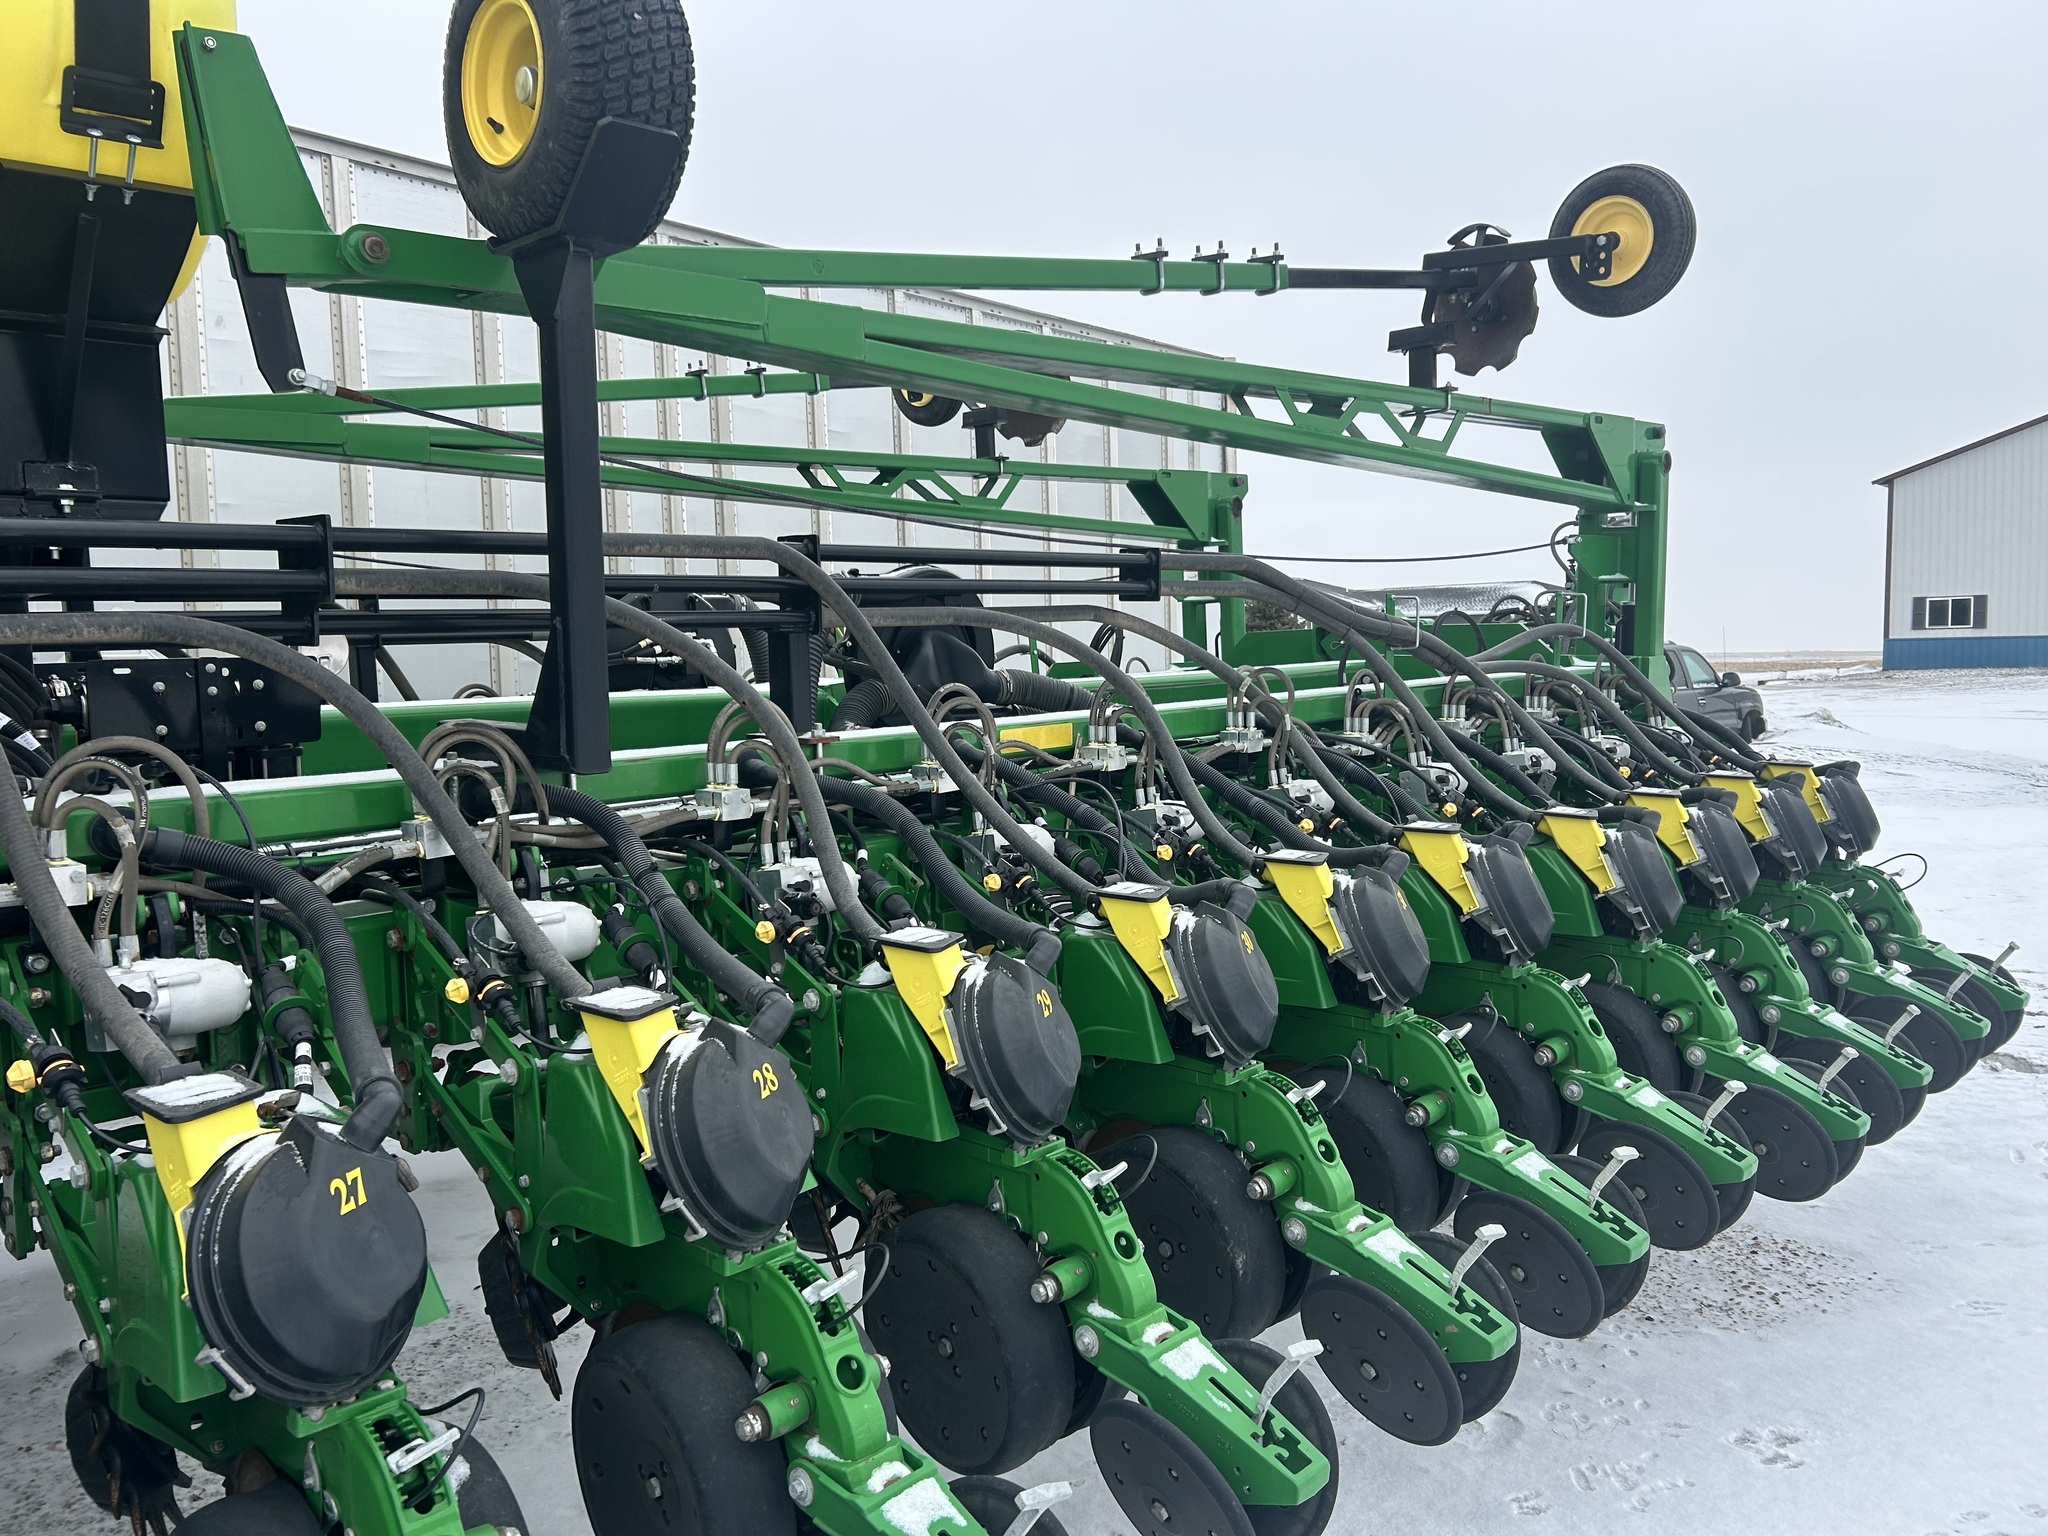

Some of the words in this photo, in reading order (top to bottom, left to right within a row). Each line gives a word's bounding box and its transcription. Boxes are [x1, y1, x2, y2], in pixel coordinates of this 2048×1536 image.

[1036, 989, 1053, 1018] 29
[752, 1062, 779, 1100] 28
[330, 1166, 368, 1216] 27
